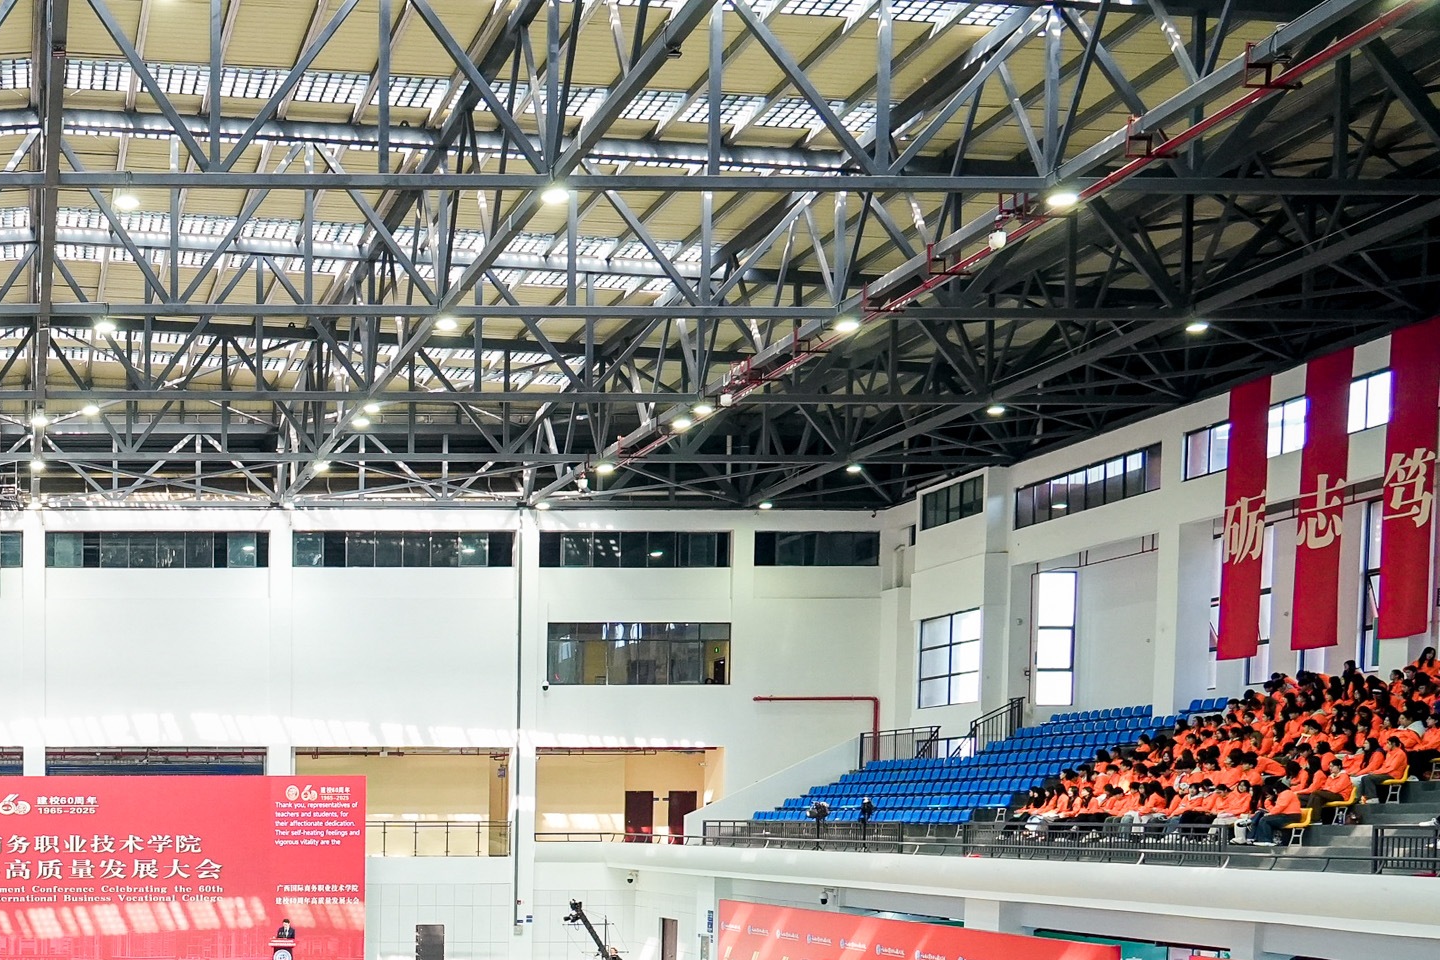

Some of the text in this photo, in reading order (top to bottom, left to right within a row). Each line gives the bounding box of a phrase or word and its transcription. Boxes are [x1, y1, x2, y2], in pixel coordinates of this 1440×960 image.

[37, 796, 98, 805] 建校60周年
[32, 885, 94, 893] Conference
[101, 885, 167, 894] Celebrating
[198, 885, 223, 893] 60th
[276, 884, 359, 892] 广西国际商务职业技术学院
[182, 895, 223, 903] College
[275, 897, 360, 905] 建校60周年高质量发展大会
